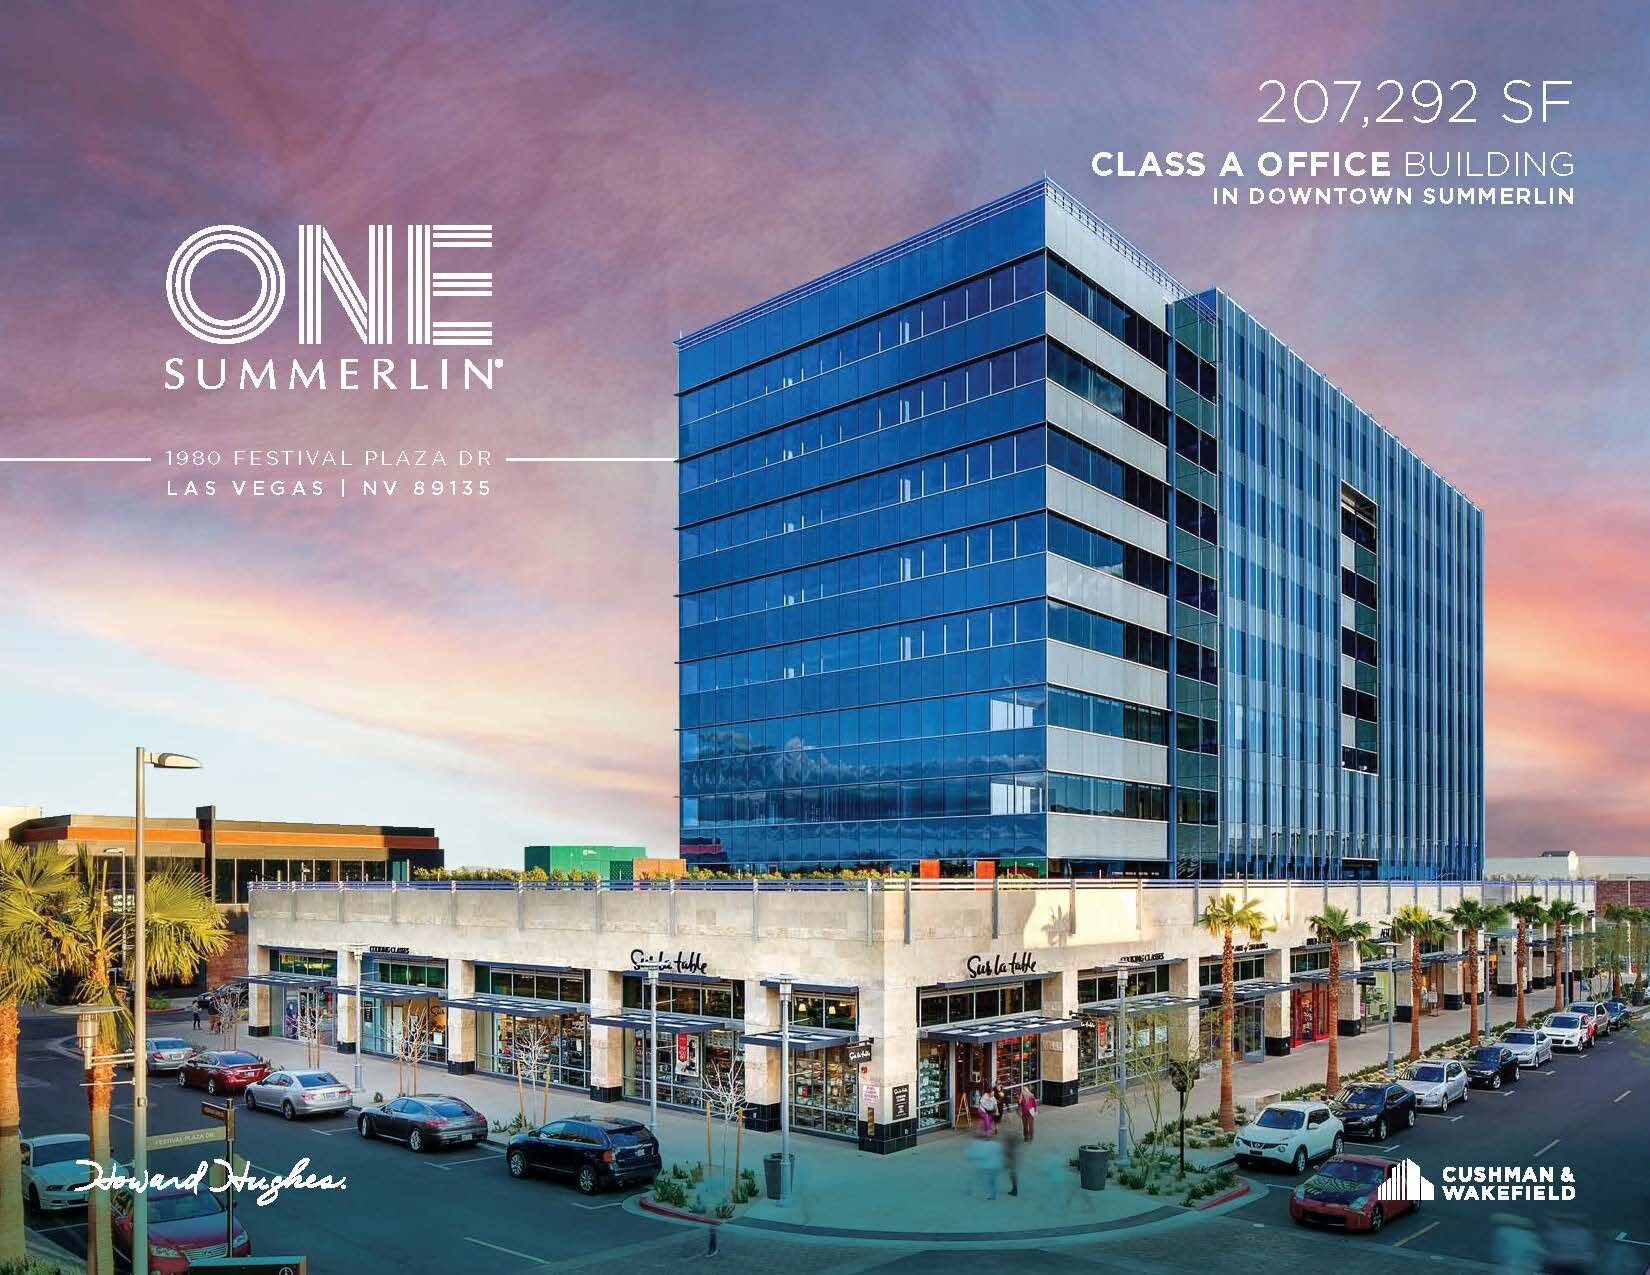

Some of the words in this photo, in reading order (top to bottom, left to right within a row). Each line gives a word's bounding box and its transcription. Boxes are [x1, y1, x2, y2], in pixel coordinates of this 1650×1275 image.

[631, 949, 654, 970] Sr
[674, 951, 708, 974] table
[967, 955, 992, 978] Sur
[994, 954, 1007, 975] la
[1008, 952, 1037, 974] table
